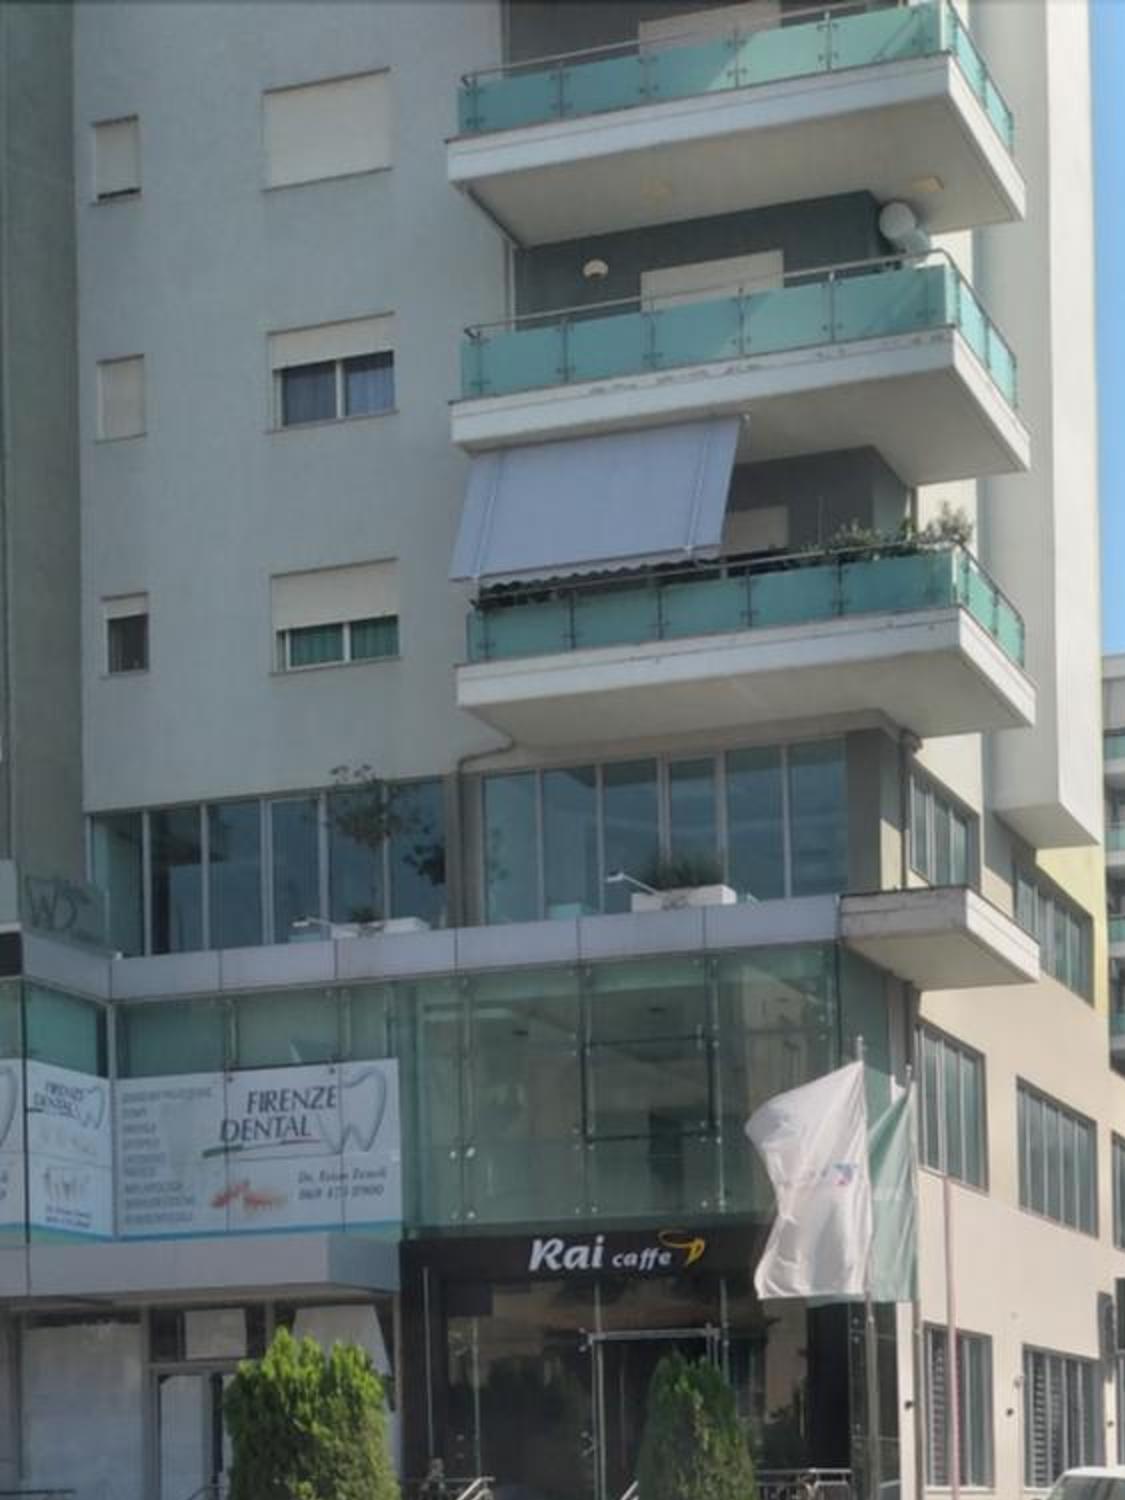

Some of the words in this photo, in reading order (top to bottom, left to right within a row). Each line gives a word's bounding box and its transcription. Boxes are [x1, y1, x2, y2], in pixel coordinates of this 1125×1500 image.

[246, 1085, 337, 1115] FIRENZE
[219, 1114, 312, 1142] DENTAL
[528, 1234, 605, 1272] Rai
[611, 1248, 672, 1271] caffe
